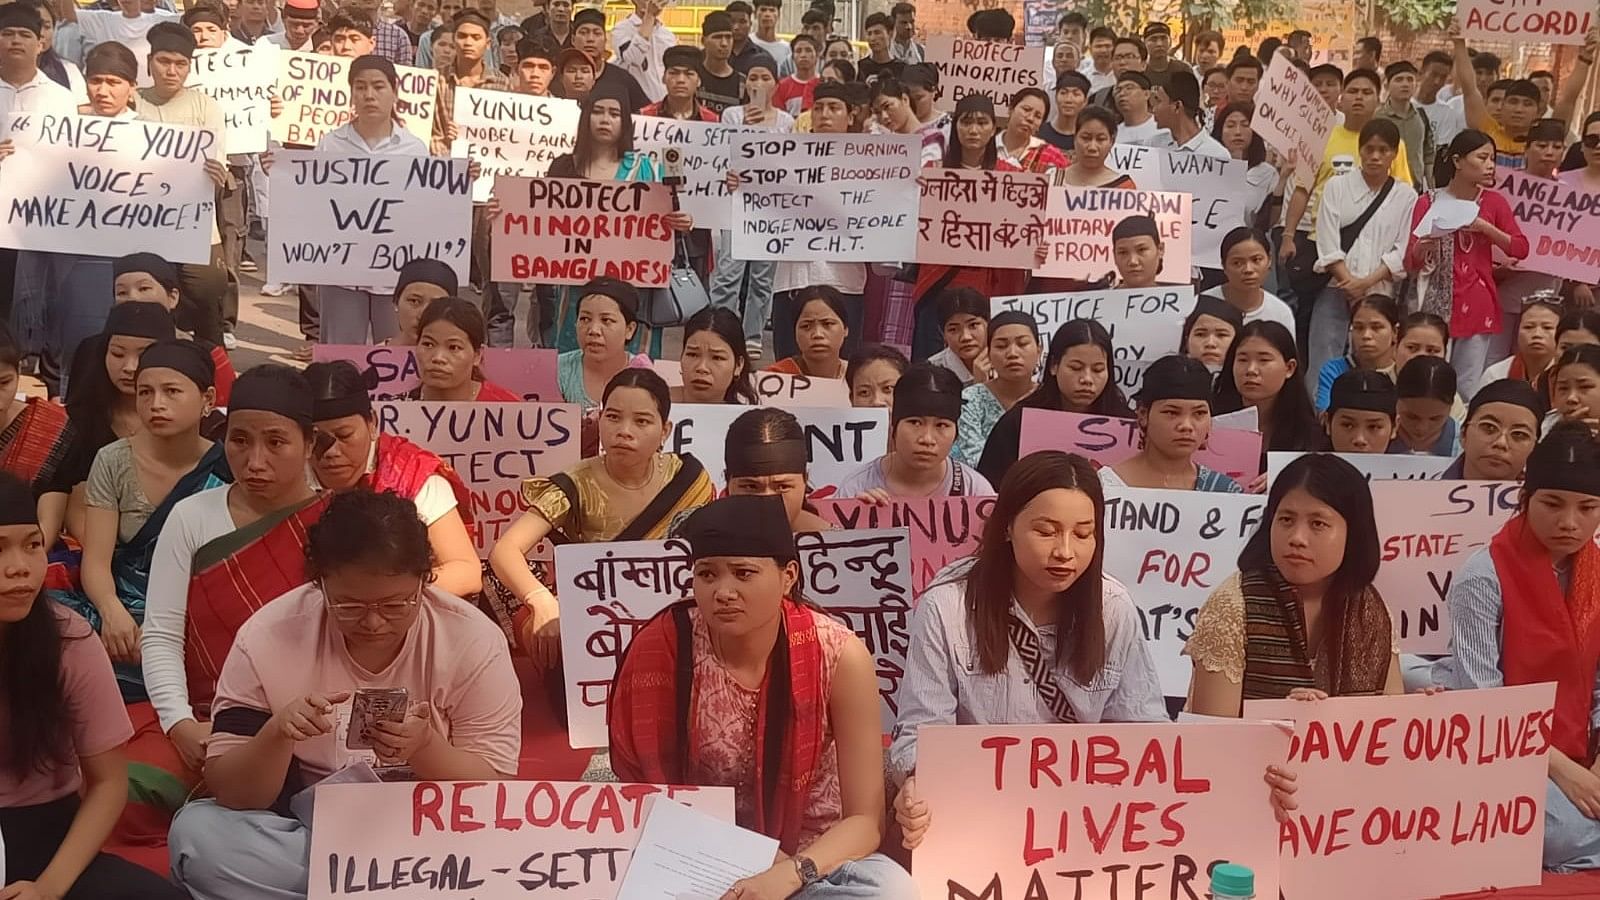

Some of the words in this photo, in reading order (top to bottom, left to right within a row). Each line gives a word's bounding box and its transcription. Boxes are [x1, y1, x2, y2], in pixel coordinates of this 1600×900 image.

[953, 39, 1025, 62] PROTECT
[288, 57, 342, 83] STOP
[935, 61, 1039, 87] MINORITIES
[282, 85, 304, 102] OF
[1271, 77, 1298, 107] WHY
[470, 94, 553, 125] YUNUS
[1259, 102, 1276, 122] ON
[140, 124, 215, 163] YOUR
[466, 126, 520, 144] NOBEL
[468, 144, 509, 161] FOR
[741, 140, 797, 159] STOP
[803, 140, 838, 157] THE
[844, 142, 908, 157] BURNING
[1114, 148, 1150, 171] WE
[1168, 152, 1230, 176] WANT
[291, 158, 392, 186] JUSTIC
[404, 158, 472, 195] NOW
[740, 168, 788, 185] STOP
[794, 166, 827, 184] THE
[830, 166, 911, 181] BLOODSHED
[529, 179, 651, 212] PROTECT
[743, 192, 814, 213] PROTECT
[840, 189, 876, 206] THE
[1064, 189, 1182, 214] WITHDRAW
[7, 195, 76, 228] MAKE
[76, 199, 98, 230] A
[330, 198, 404, 234] WE
[743, 218, 839, 235] INDIGENOUS
[847, 214, 908, 230] PEOPLE
[1513, 200, 1582, 233] ARMY
[504, 213, 673, 241] MINORITIES
[564, 238, 592, 254] IN
[766, 237, 795, 254] OF
[807, 235, 865, 253] C.H.T.
[1055, 241, 1109, 262] FROM
[1002, 298, 1105, 325] JUSTICE
[1125, 292, 1180, 319] FOR
[421, 406, 570, 447] YUNUS
[1137, 549, 1211, 588] FOR
[1403, 713, 1472, 765] OUR
[1478, 708, 1555, 765] LIVES
[981, 735, 1211, 793] TRIBAL
[412, 780, 702, 837] RELOCAT
[1361, 806, 1442, 846] OUR
[1451, 796, 1538, 846] LAND
[1023, 801, 1190, 866] LIVES
